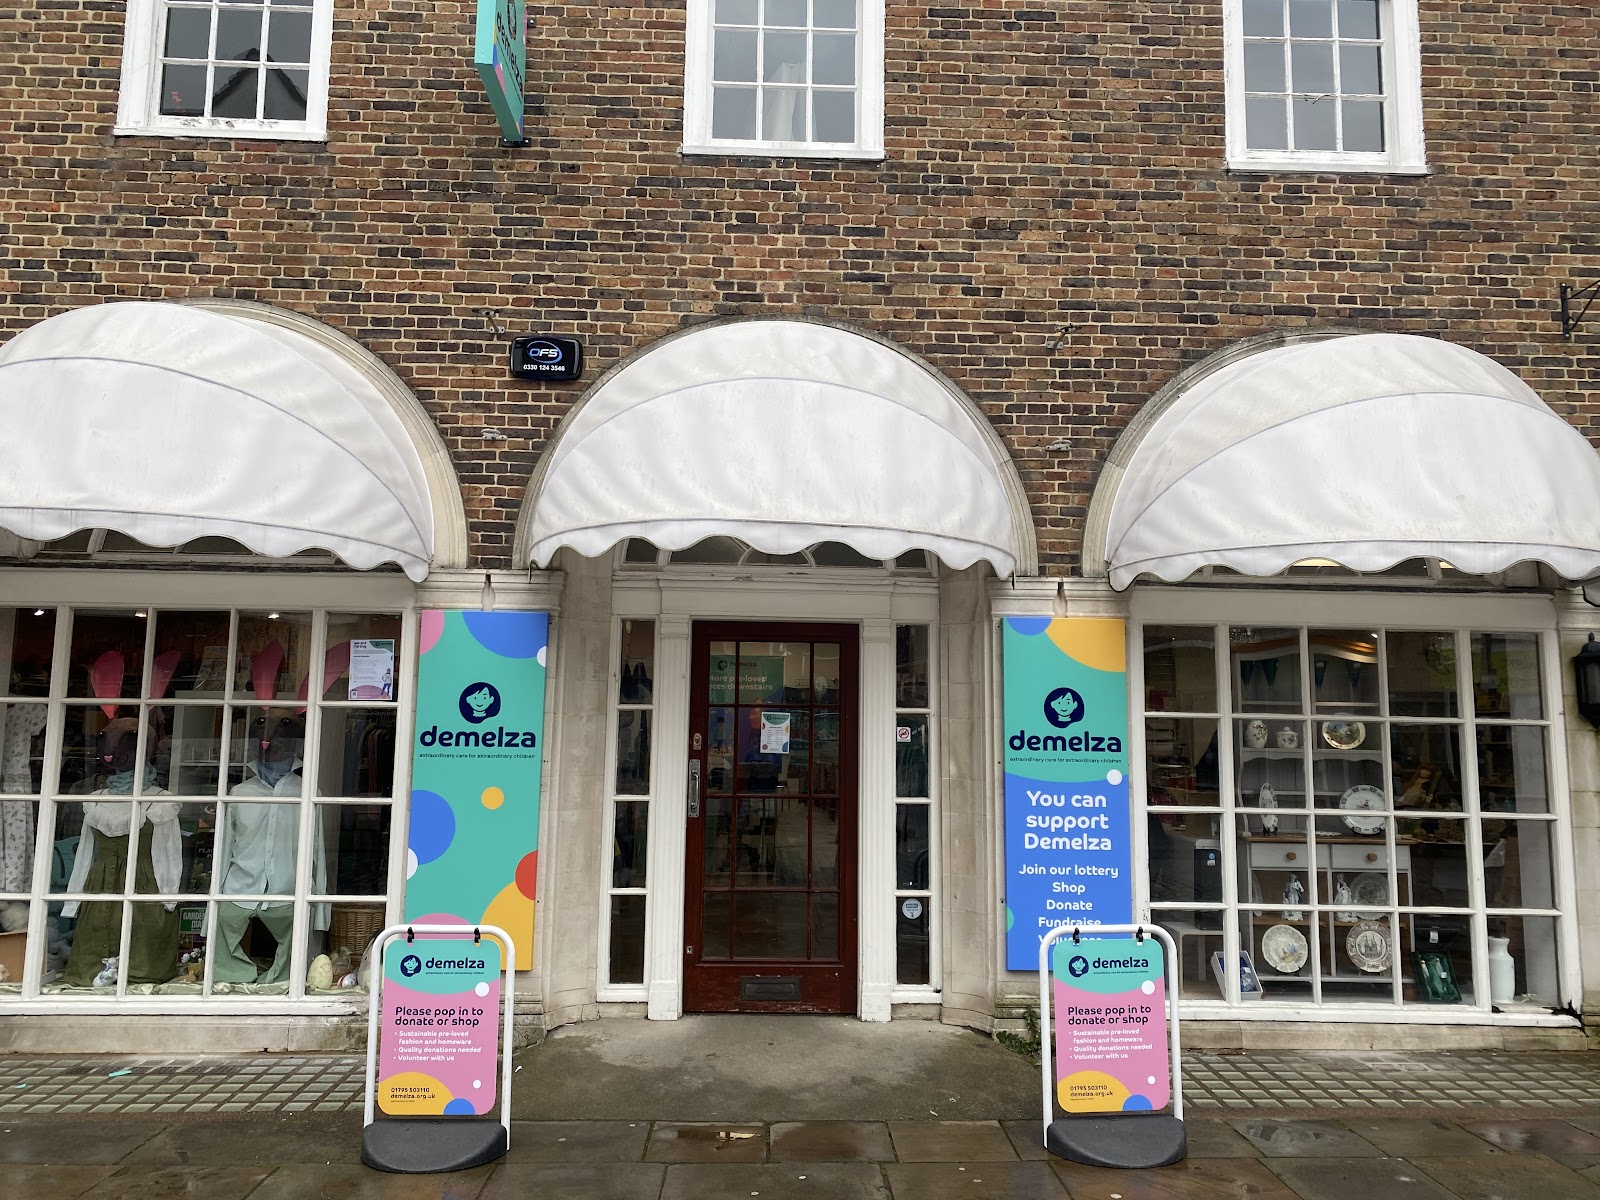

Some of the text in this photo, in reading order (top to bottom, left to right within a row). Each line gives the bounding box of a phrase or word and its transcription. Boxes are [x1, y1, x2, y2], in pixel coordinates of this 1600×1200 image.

[496, 11, 524, 98] demelza
[729, 674, 768, 683] pe-loved
[419, 725, 537, 748] demelza
[1009, 730, 1122, 752] demelza
[419, 752, 455, 760] extraordinary
[1065, 757, 1100, 765] extraordinary
[1026, 790, 1107, 808] You can
[1026, 813, 1109, 833] support
[1024, 832, 1112, 851] Demelza
[1019, 864, 1119, 879] Join our lottery
[1052, 881, 1086, 895] Shop
[1046, 899, 1093, 910] Donate
[183, 912, 205, 920] GARDE
[1038, 916, 1102, 928] Fundraise
[425, 957, 485, 969] demelza
[1092, 957, 1149, 969] demelza
[395, 1006, 484, 1018] Please pop in to
[1068, 1005, 1151, 1016] Please pop in to
[395, 1016, 480, 1028] donate or shop
[1068, 1016, 1105, 1025] donate
[1122, 1015, 1149, 1025] shop
[438, 1030, 469, 1038] pre-loved
[1110, 1028, 1140, 1036] pre-loved
